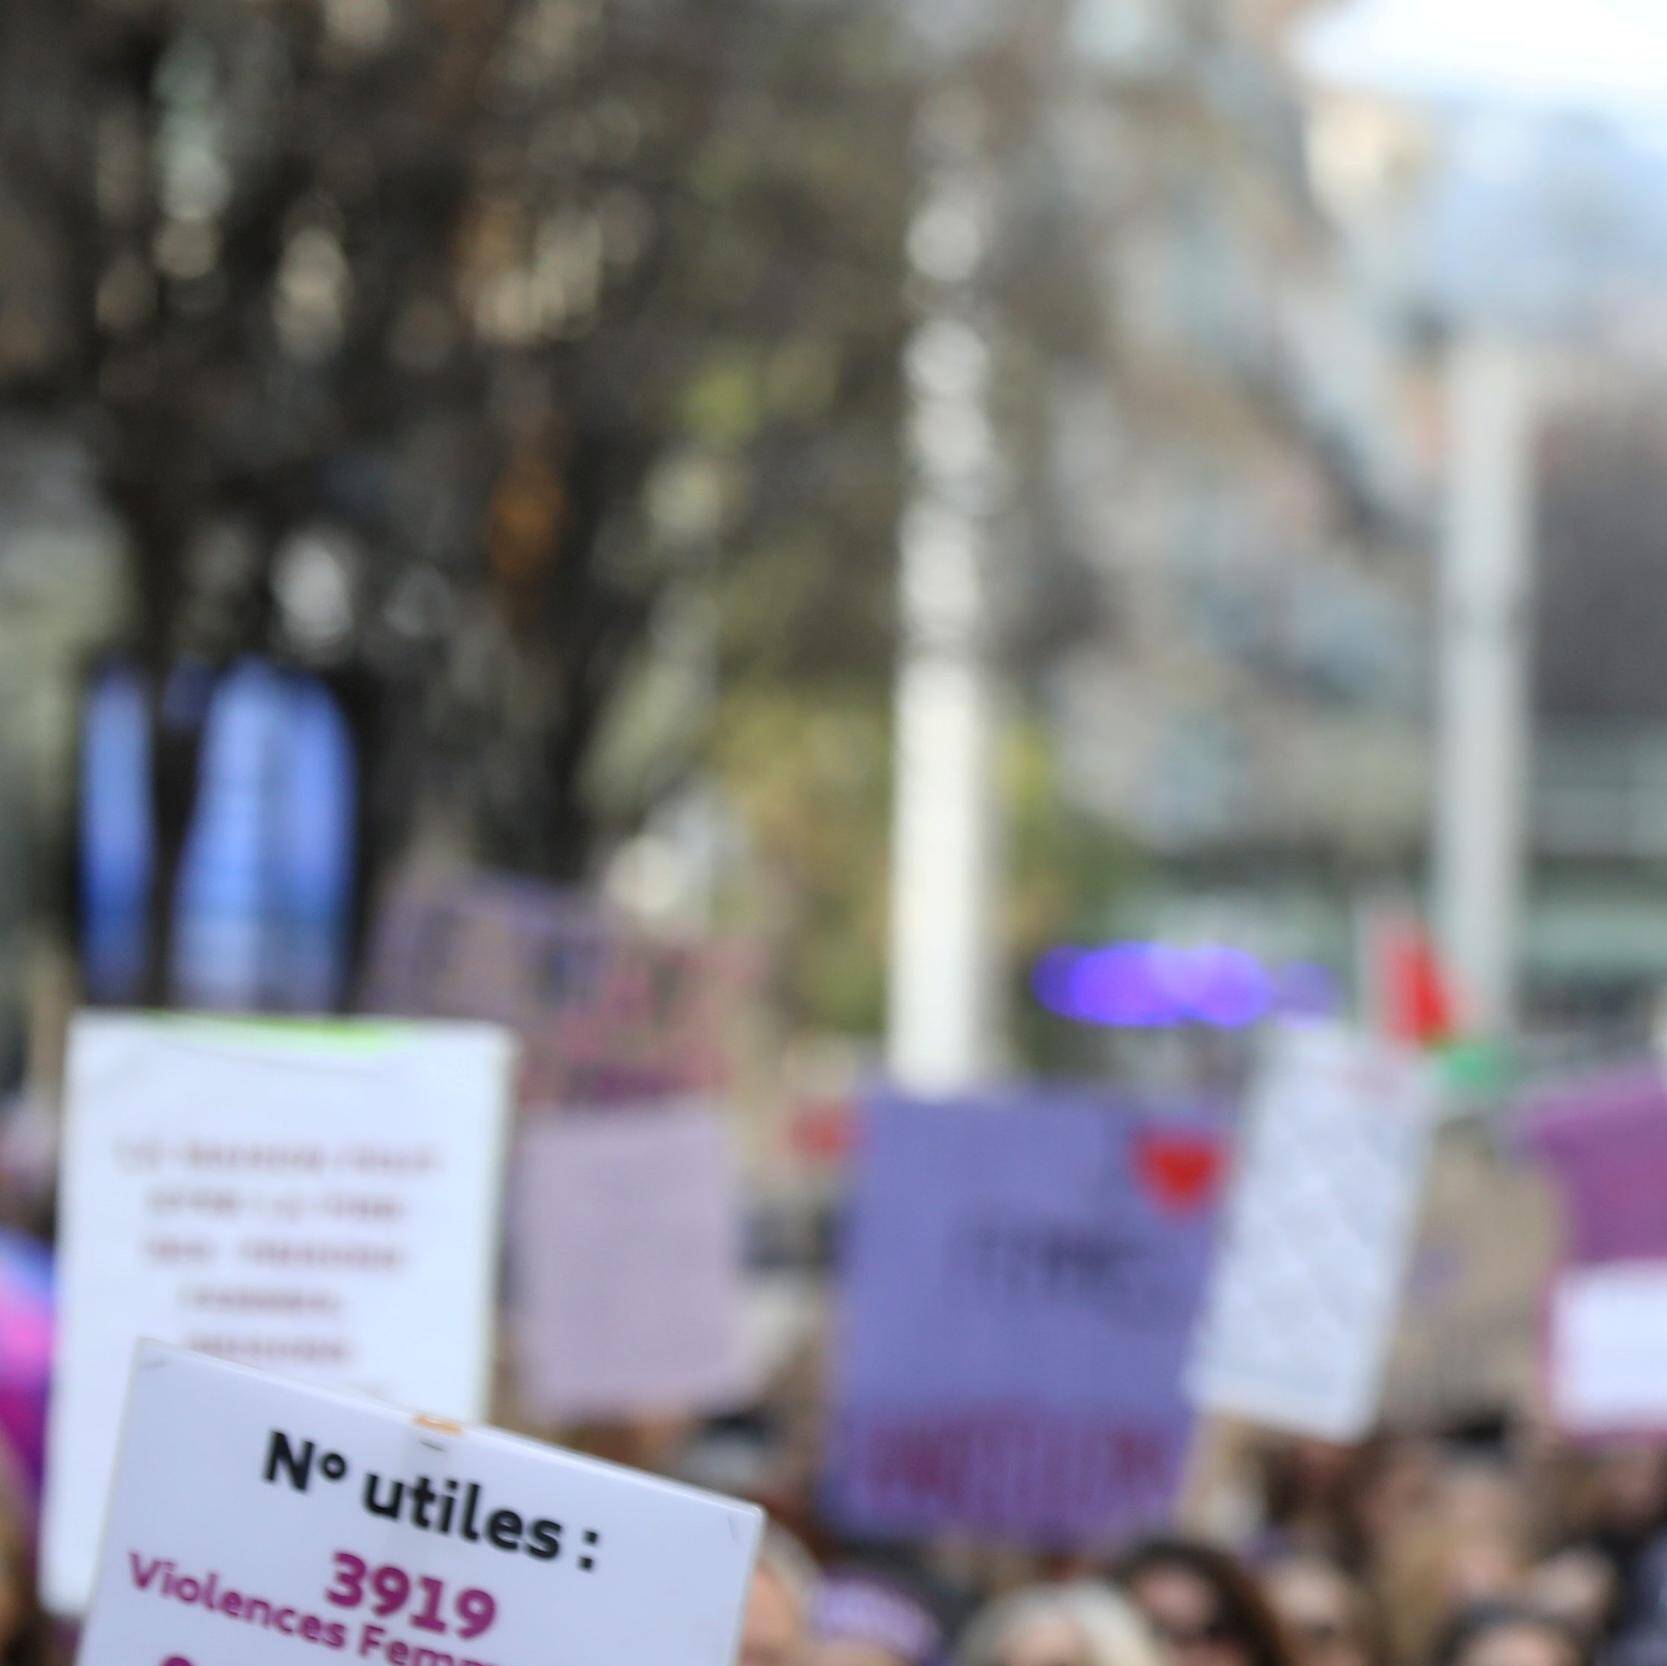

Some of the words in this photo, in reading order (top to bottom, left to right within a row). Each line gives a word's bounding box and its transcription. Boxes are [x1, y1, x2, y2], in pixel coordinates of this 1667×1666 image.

[362, 1470, 564, 1564] utiles
[128, 1551, 347, 1652] Violences
[328, 1551, 498, 1641] 3919
